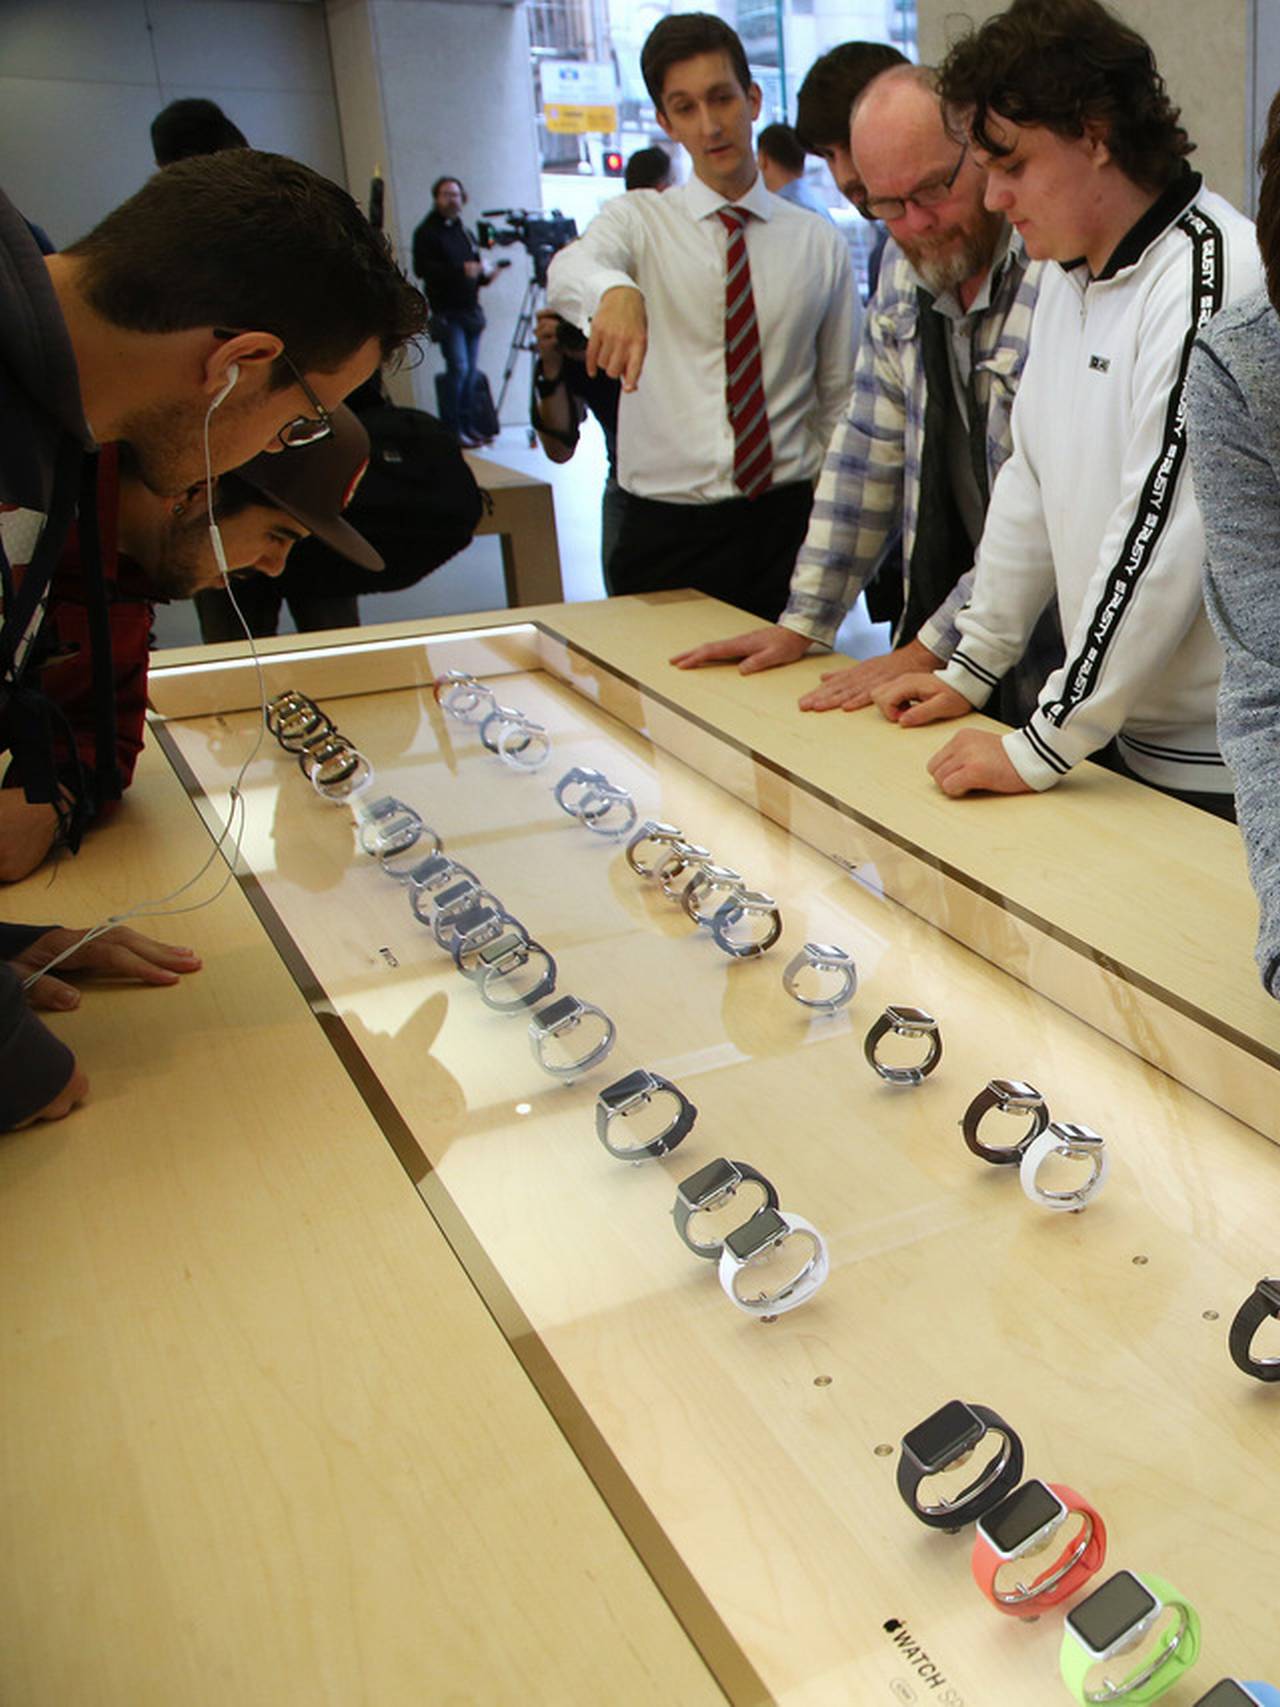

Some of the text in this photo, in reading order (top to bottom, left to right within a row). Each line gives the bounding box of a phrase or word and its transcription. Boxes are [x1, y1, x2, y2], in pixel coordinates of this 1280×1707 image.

[1150, 457, 1174, 510] RUSTY
[1124, 525, 1153, 576] RUSTY
[1094, 591, 1124, 643] RUSTY
[1070, 659, 1093, 704] RUSTY
[893, 1629, 946, 1689] WATCH
